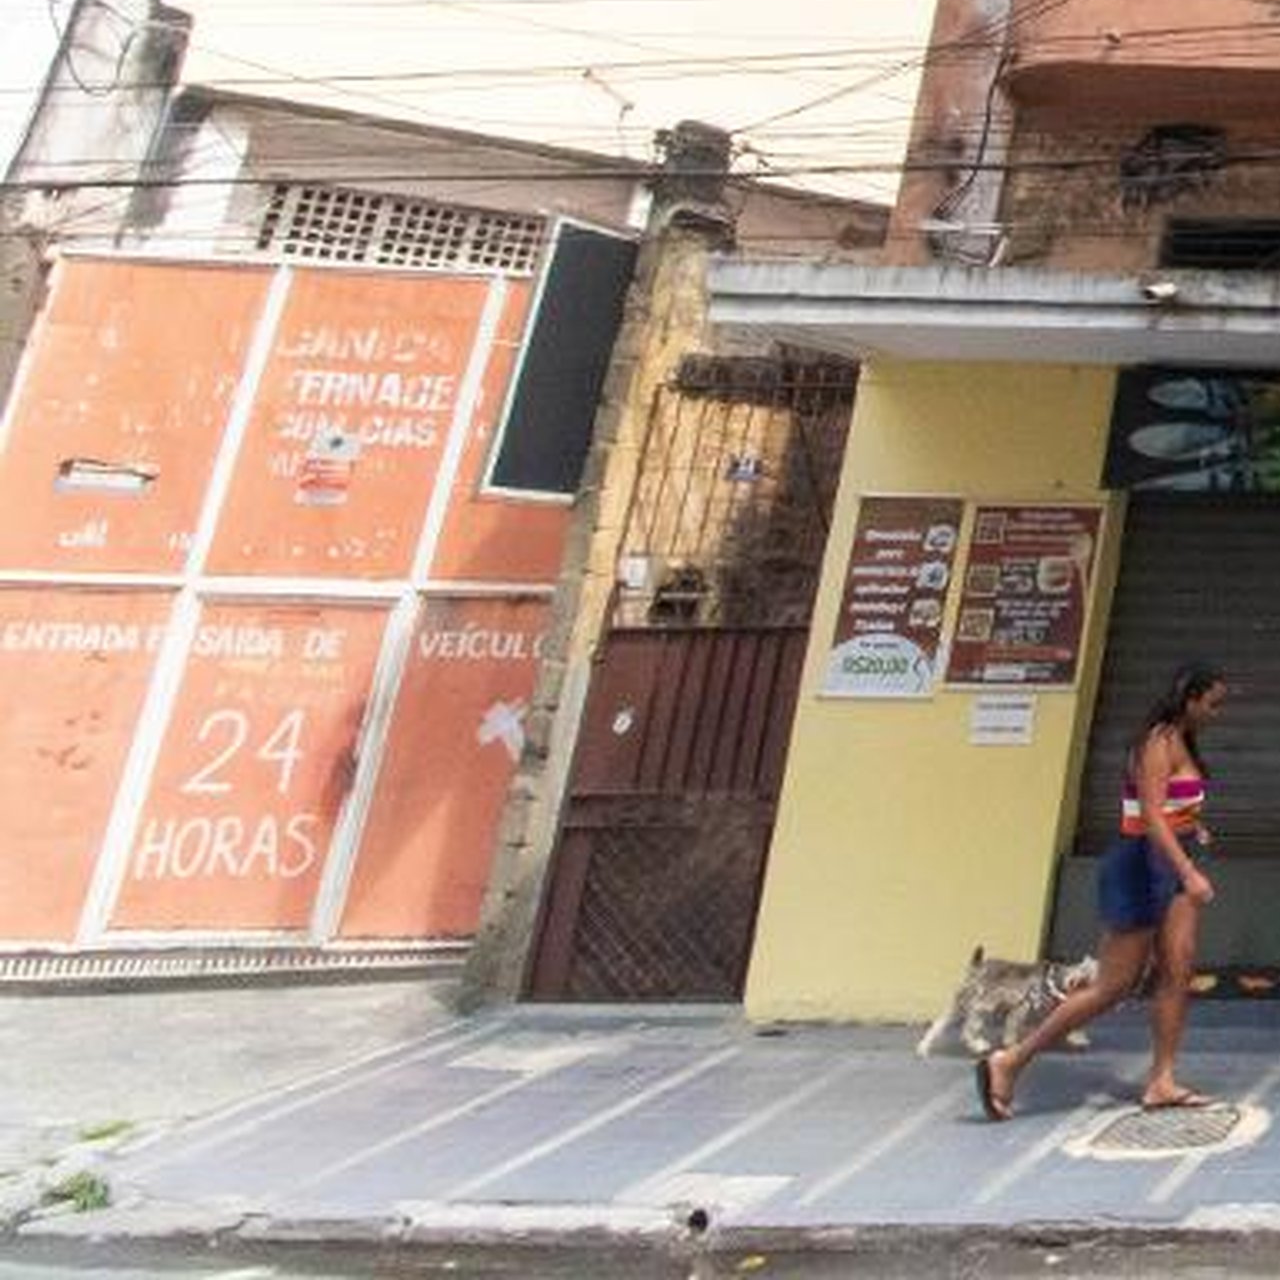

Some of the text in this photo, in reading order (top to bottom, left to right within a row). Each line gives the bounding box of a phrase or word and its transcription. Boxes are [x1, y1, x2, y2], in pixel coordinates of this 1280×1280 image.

[3, 621, 138, 651] ENTRADA
[304, 629, 348, 660] DE
[179, 707, 307, 795] 24
[134, 812, 318, 881] HORAS
